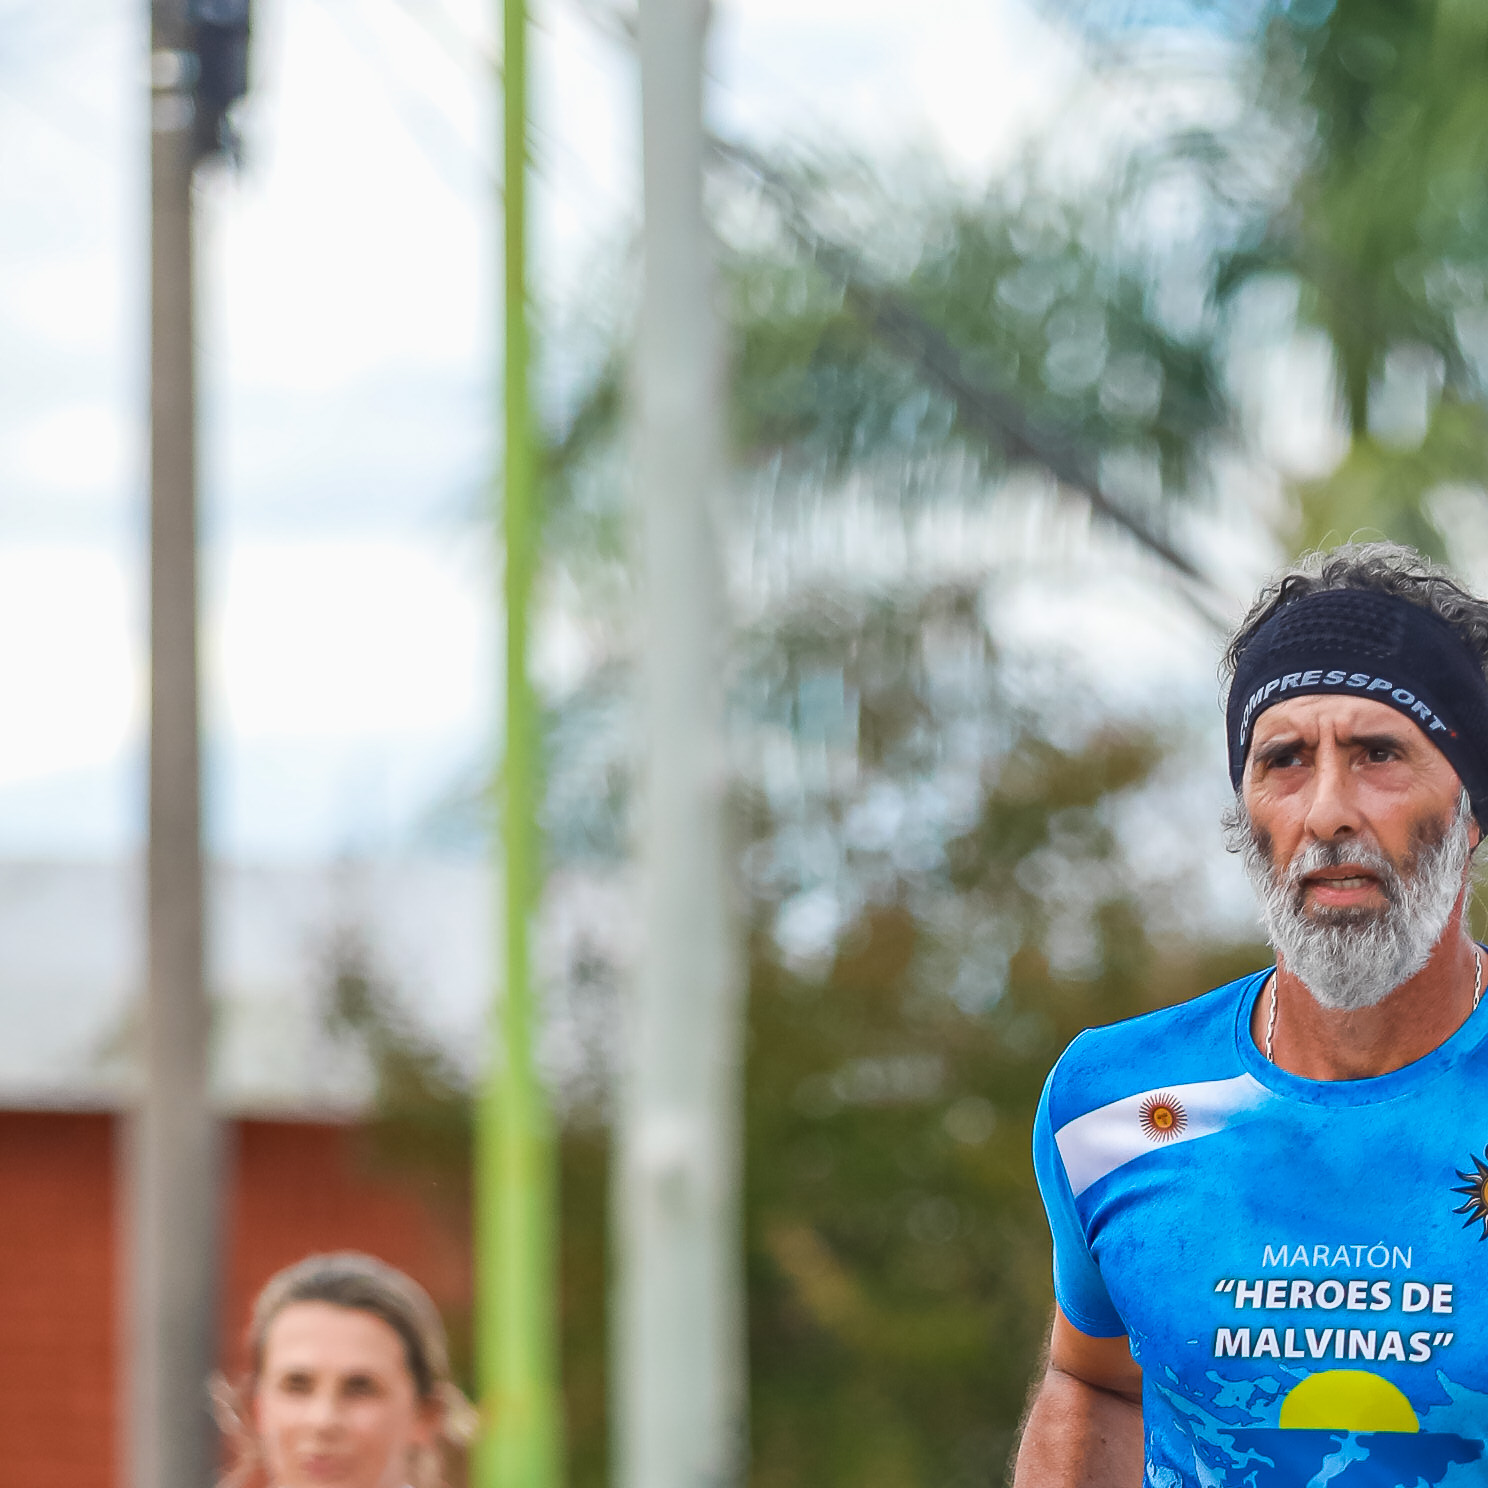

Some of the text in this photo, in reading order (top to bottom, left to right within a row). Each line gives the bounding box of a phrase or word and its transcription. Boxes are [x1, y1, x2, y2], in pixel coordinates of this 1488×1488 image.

[1240, 669, 1447, 745] COMPRESSPORT
[1261, 1240, 1412, 1270] MARATÓN
[1214, 1279, 1454, 1314] “HEROES DE
[1214, 1327, 1454, 1363] MALVINAS”
